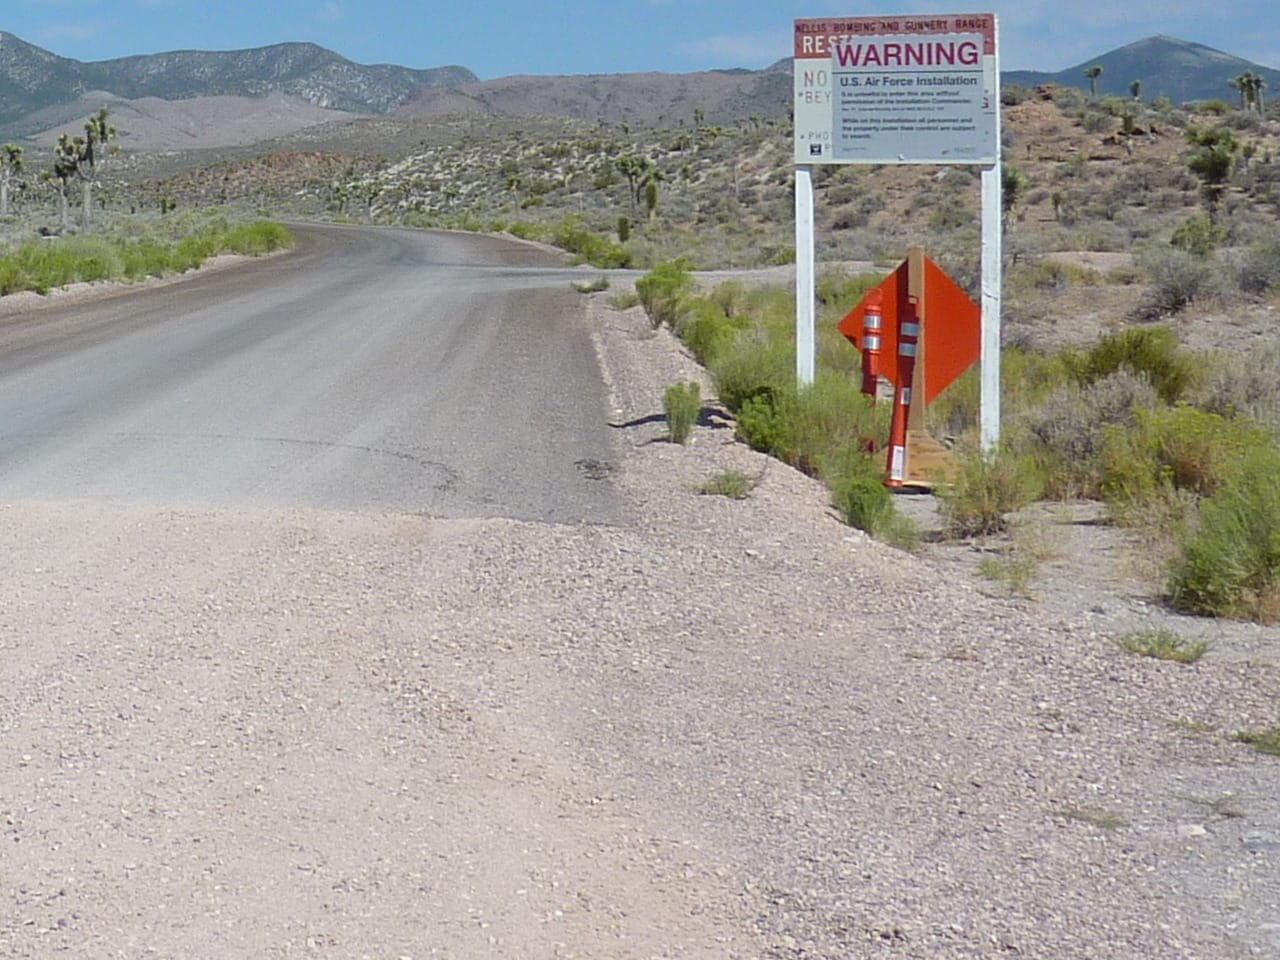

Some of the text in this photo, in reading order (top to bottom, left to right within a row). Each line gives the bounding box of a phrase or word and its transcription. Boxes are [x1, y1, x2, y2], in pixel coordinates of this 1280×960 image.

[833, 21, 875, 32] BOMBING
[881, 21, 900, 31] AND
[905, 19, 948, 30] GUNNERY
[955, 18, 989, 29] RANGE
[836, 42, 978, 67] WARNING
[804, 70, 827, 88] NO
[840, 75, 977, 87] U.S. Air Force Installation
